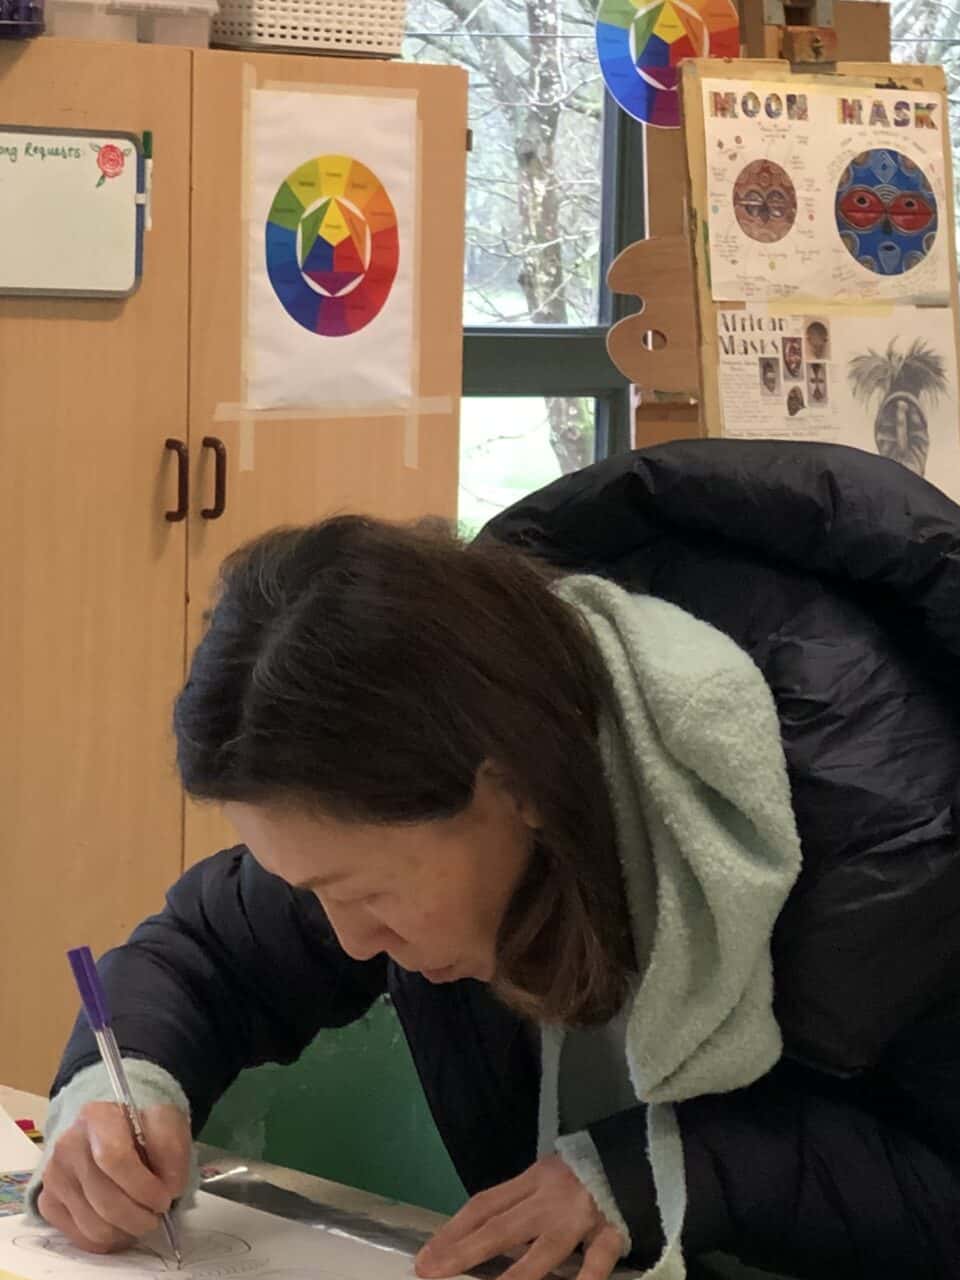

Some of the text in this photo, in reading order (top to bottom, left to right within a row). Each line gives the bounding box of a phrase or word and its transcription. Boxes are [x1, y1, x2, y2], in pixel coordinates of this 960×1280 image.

[710, 91, 938, 130] MOON MASK
[25, 142, 80, 160] Requests
[722, 313, 787, 332] African
[720, 336, 779, 355] Masks
